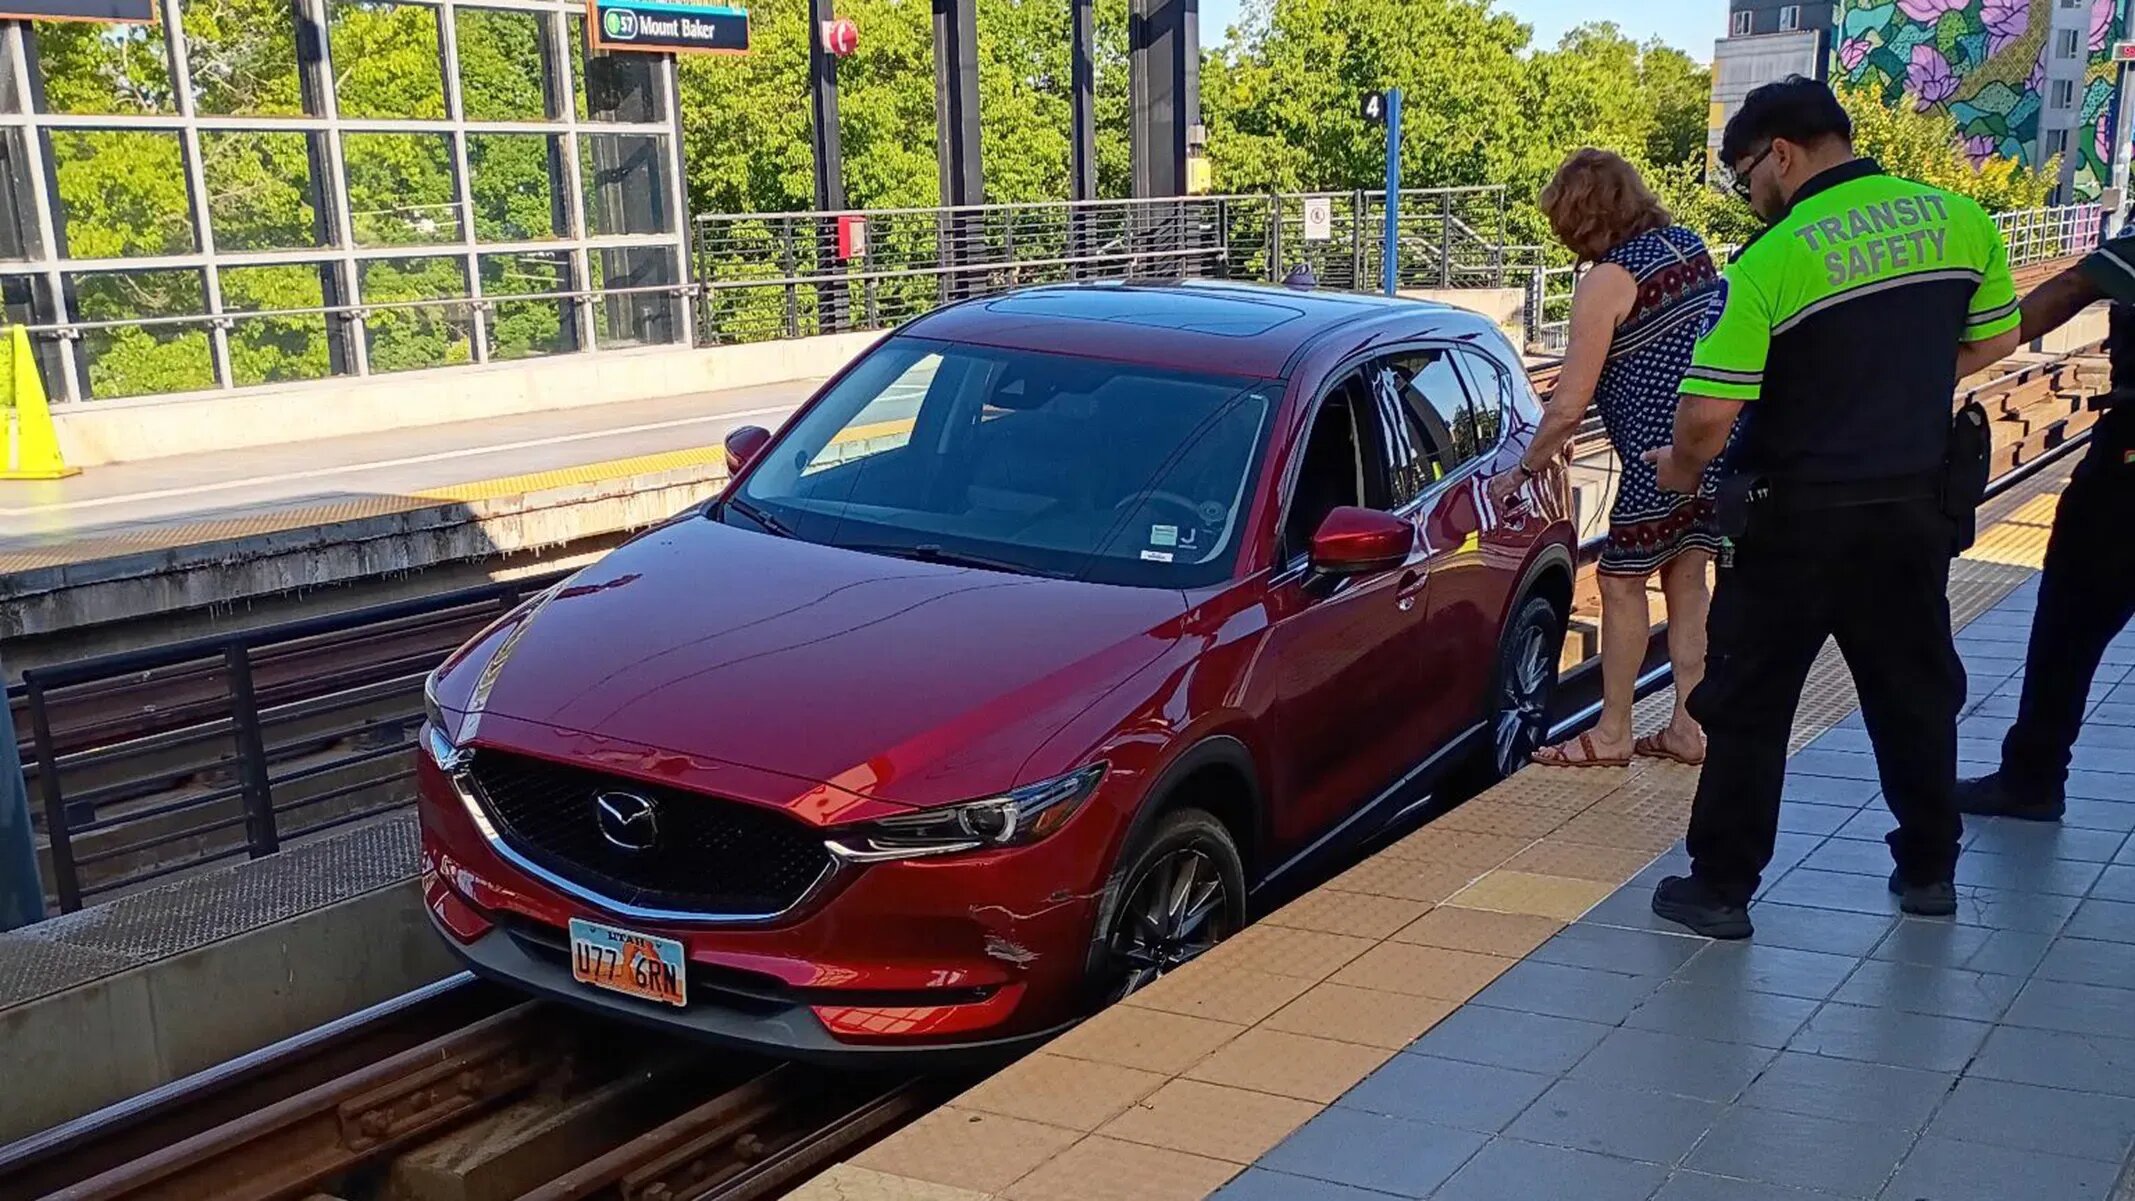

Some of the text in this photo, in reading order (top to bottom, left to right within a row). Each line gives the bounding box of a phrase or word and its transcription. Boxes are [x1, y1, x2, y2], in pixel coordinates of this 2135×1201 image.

[620, 16, 634, 33] 57
[639, 16, 679, 37] Mount
[681, 19, 715, 39] Baker
[1366, 95, 1380, 118] 4
[1795, 195, 1948, 250] TRANSIT
[1825, 228, 1945, 286] SAFETY
[608, 931, 645, 946] UTAH
[577, 942, 676, 994] U77 6RN
